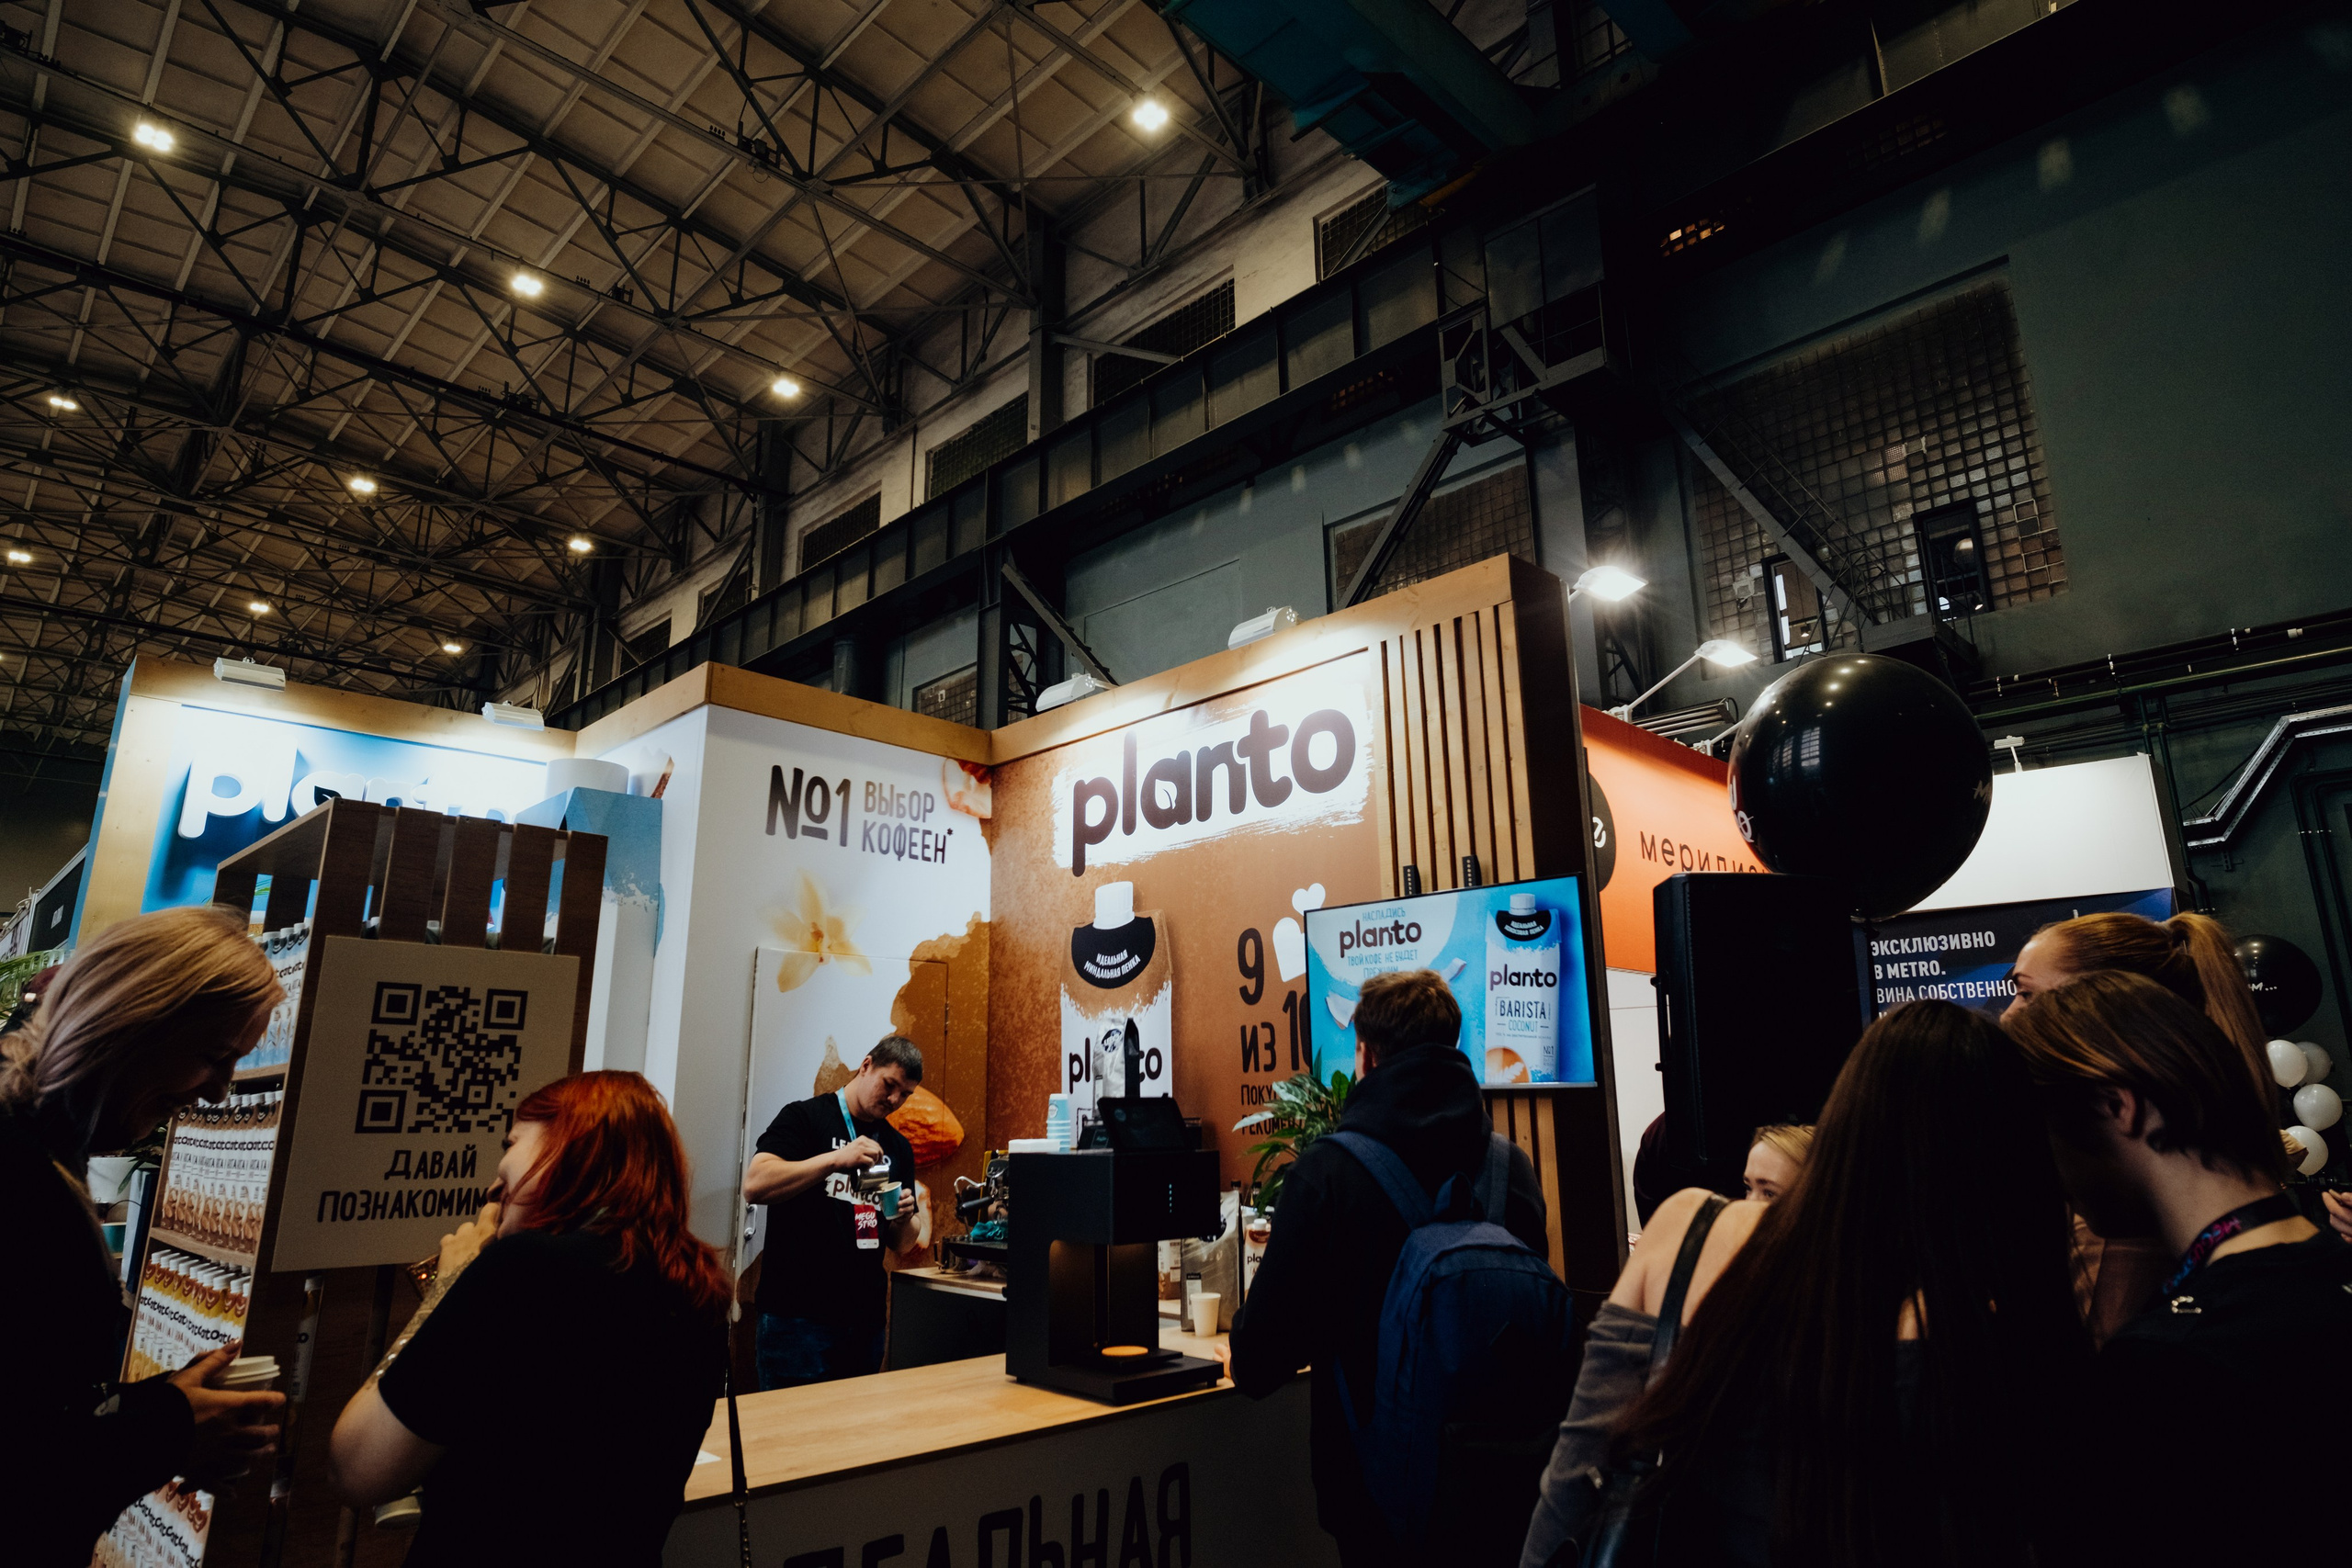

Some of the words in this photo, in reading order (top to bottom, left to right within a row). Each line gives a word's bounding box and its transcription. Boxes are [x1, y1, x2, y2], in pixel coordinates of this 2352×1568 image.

[864, 781, 935, 823] ВЫБОР
[1072, 709, 1356, 877] planto
[1340, 919, 1422, 958] planto
[1871, 931, 1996, 956] ЭКСКЛЮЗИВНО
[1084, 960, 1121, 979] МИНДАЛЬНАЯ
[1121, 954, 1141, 976] ПЕНКА
[1096, 949, 1128, 966] ИДЕАЛЬНАЯ
[1238, 928, 1264, 1005] 9
[1347, 953, 1363, 966] ТВОЙ
[1364, 953, 1382, 964] КОФЕ
[1385, 952, 1394, 963] НЕ
[1874, 964, 1883, 980] В
[1886, 960, 1947, 979] METRO.
[1489, 964, 1557, 991] planto
[1876, 986, 1916, 1004] ВИНА
[1918, 979, 2018, 1001] СОБСТВЕННО
[1499, 999, 1546, 1020] BARISTA
[1508, 1019, 1538, 1032] COCONUT
[1240, 1021, 1277, 1073] ИЗ
[384, 1144, 477, 1180] ДАВАЙ
[317, 1188, 489, 1223] ПОЗНАКОМИМ
